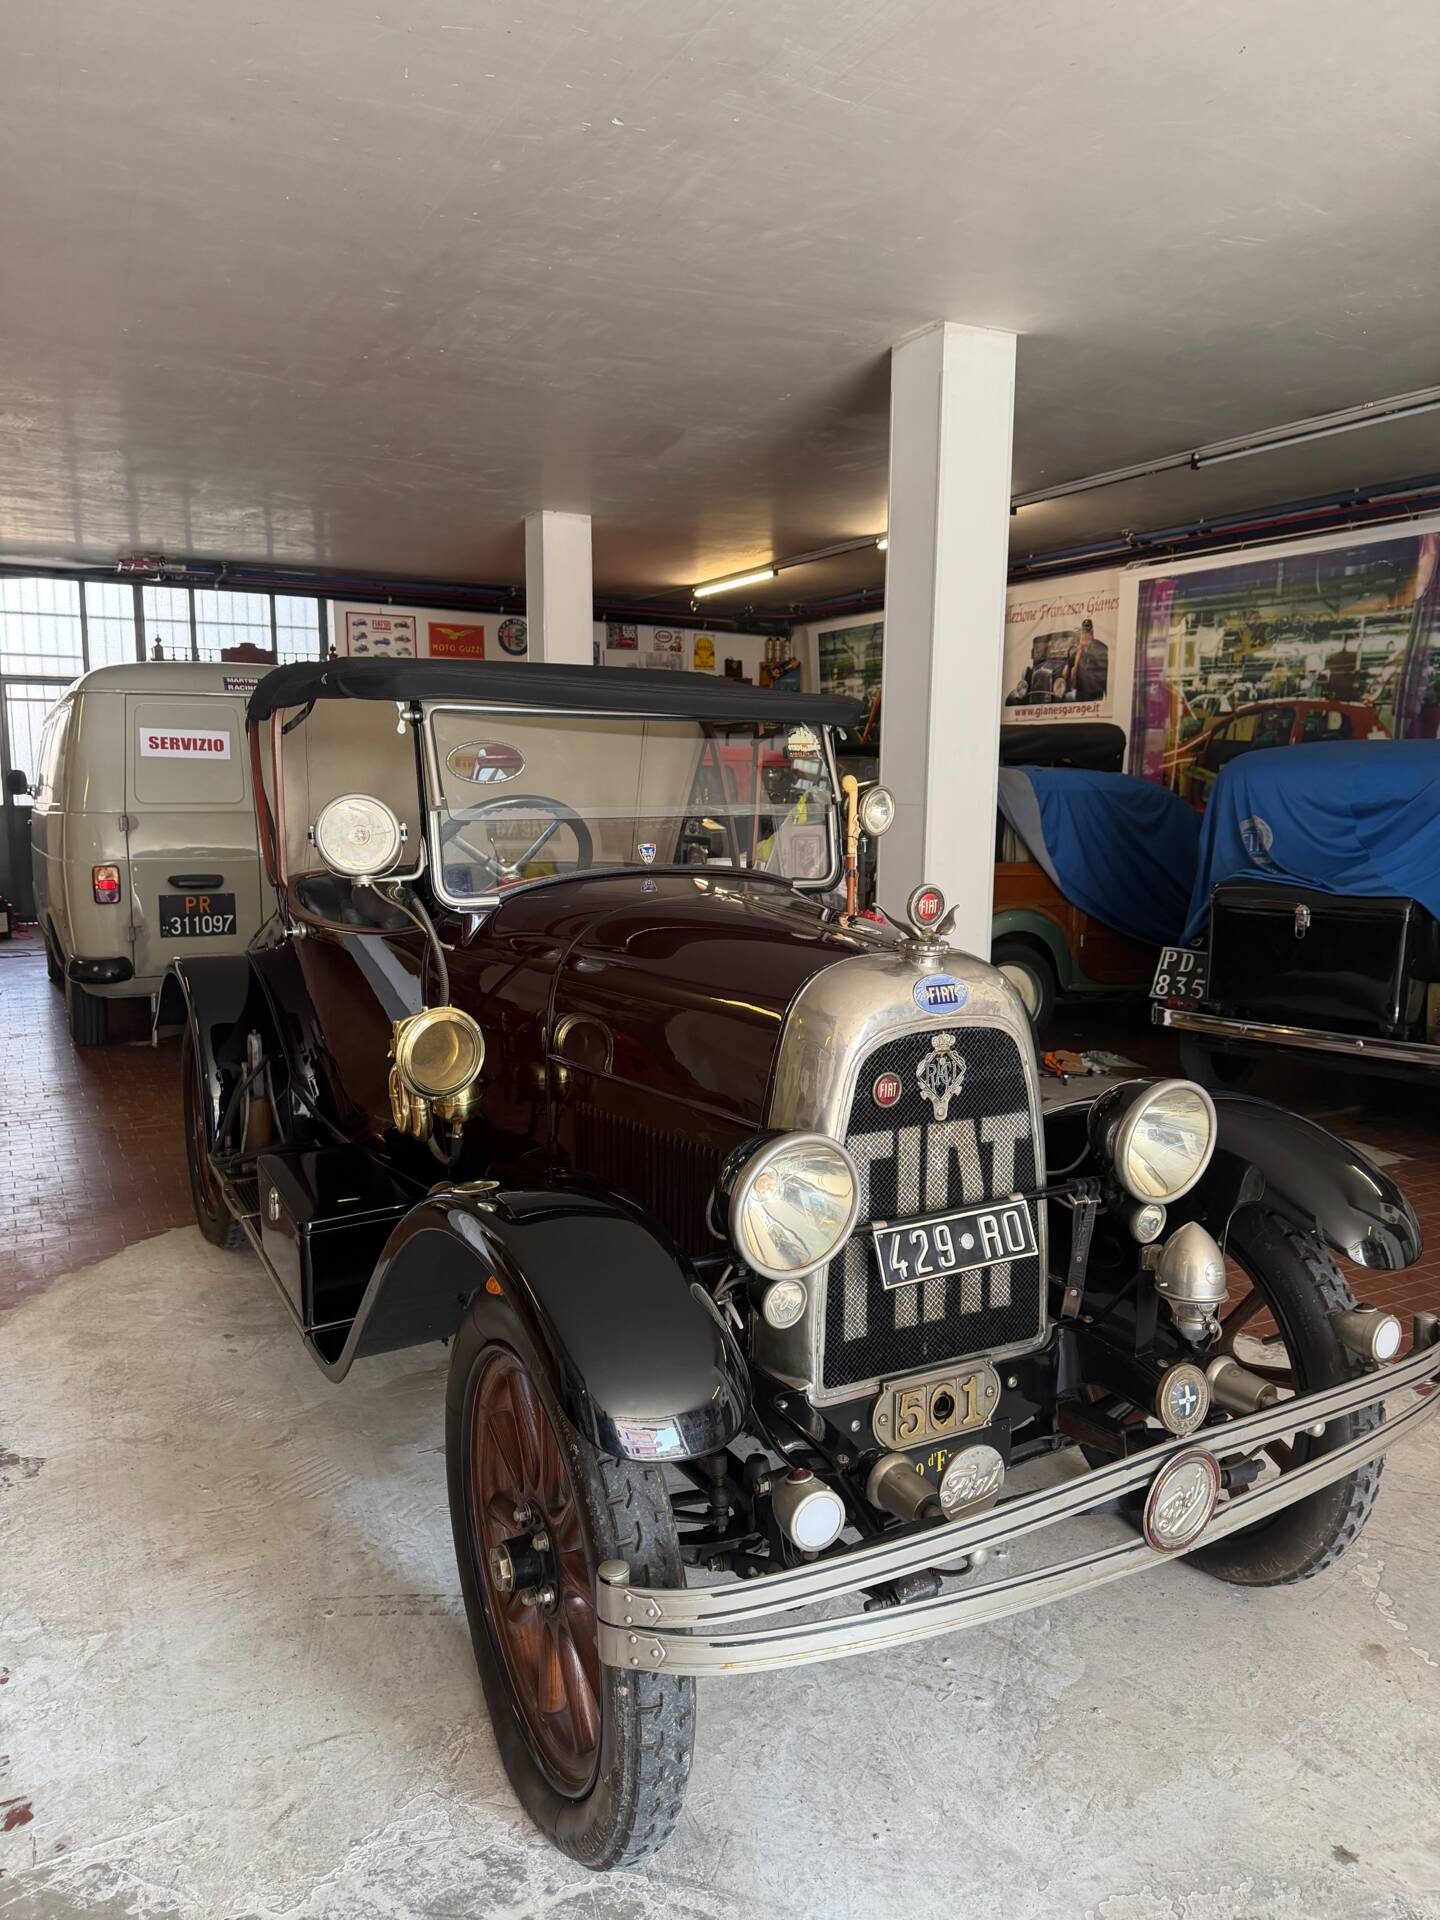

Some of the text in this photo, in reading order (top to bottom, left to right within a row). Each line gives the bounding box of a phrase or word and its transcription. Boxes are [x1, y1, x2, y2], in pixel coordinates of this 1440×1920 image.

[1039, 600, 1085, 620] Francesco
[432, 643, 456, 653] MOTO
[1014, 702, 1100, 718] www.gianesgarage.it
[148, 735, 225, 753] SERVIZIO
[184, 895, 211, 914] PR
[918, 899, 938, 915] FIAT
[170, 914, 234, 935] 311097
[927, 984, 955, 1004] FIAT
[1155, 974, 1207, 999] 835
[879, 1081, 898, 1098] FIAT
[889, 1224, 957, 1281] 429
[899, 1375, 984, 1440] 501
